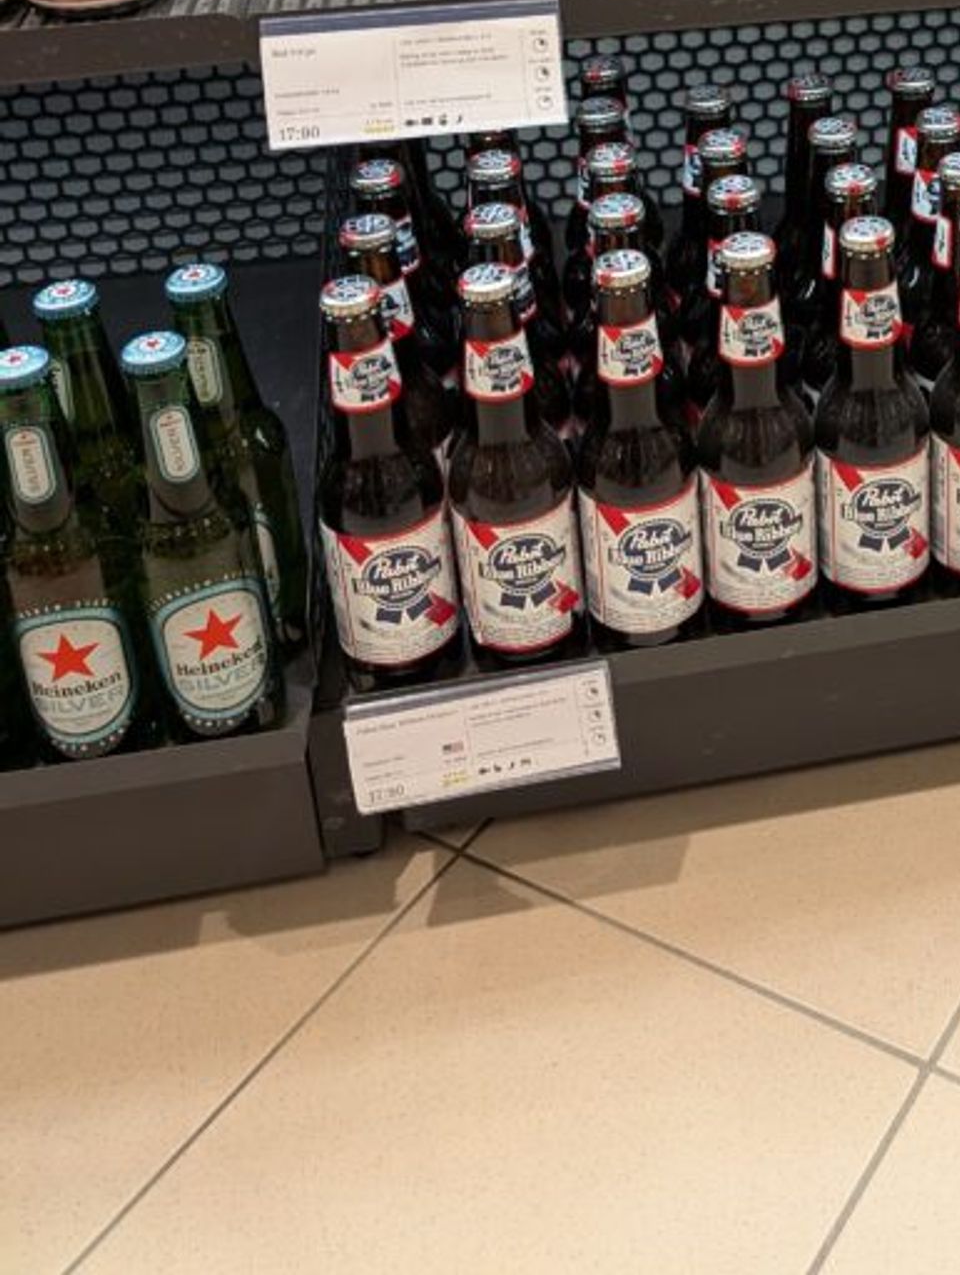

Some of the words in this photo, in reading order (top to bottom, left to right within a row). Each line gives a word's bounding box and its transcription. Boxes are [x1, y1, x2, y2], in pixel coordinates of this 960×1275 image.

[861, 486, 903, 507] Pabst
[739, 506, 783, 528] Pabst
[630, 527, 673, 550] Pabst
[499, 541, 544, 565] Pabst
[373, 555, 419, 579] Pabst
[176, 635, 264, 676] Heineken
[32, 672, 121, 698] Heineken
[34, 685, 125, 713] SILVER
